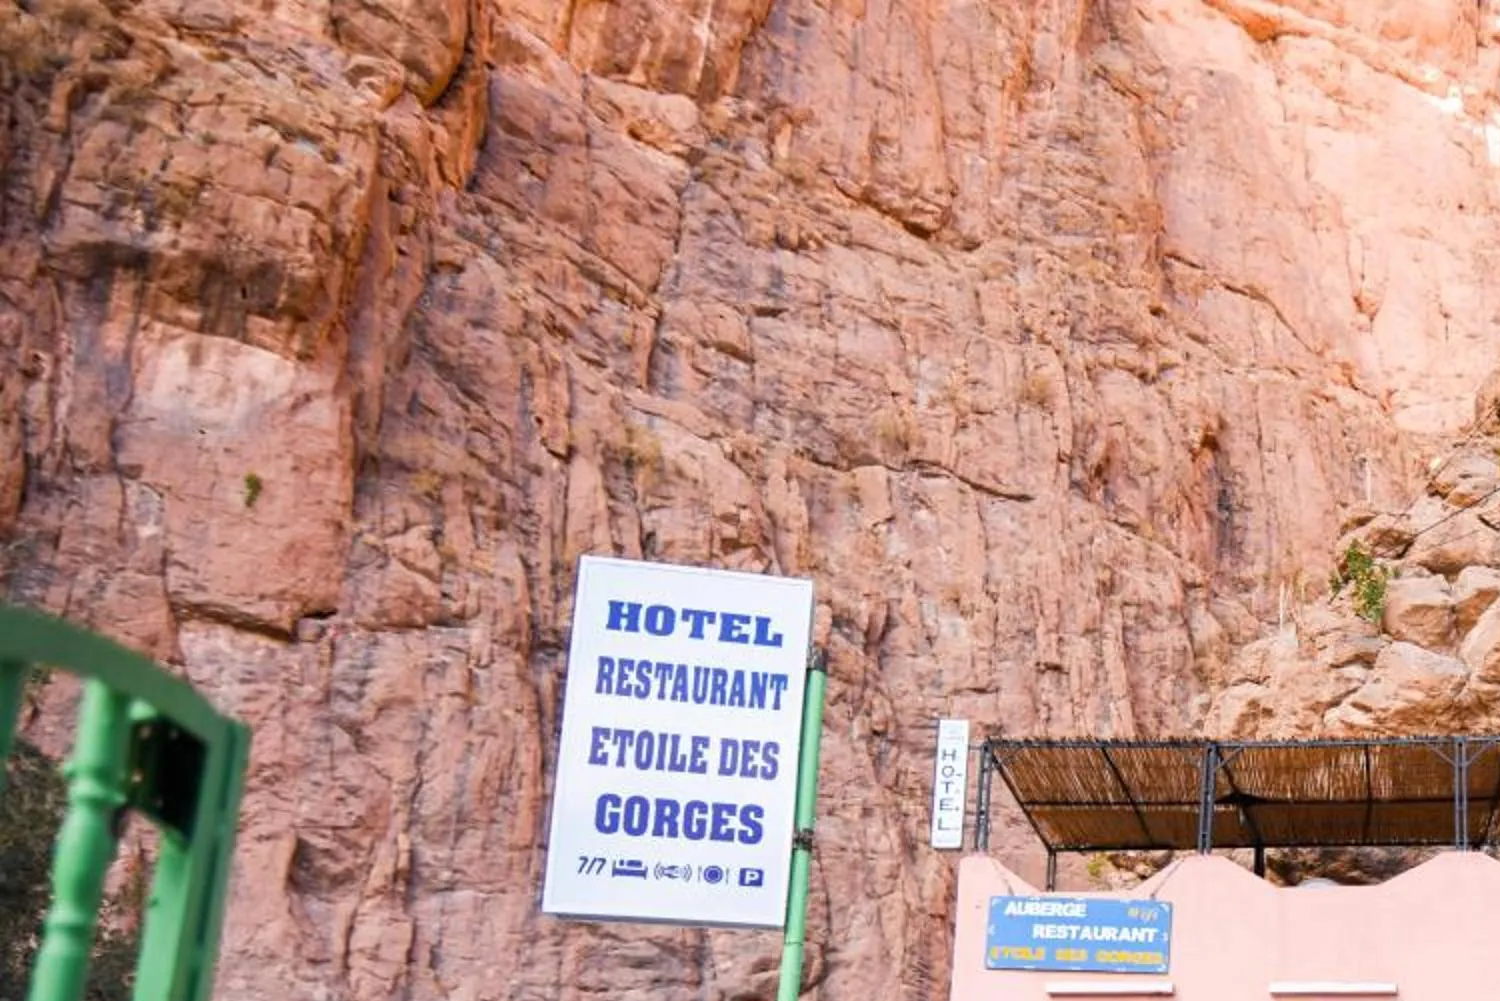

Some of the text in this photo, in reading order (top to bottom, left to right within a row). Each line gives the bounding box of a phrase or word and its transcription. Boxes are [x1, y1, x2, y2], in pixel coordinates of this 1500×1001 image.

[606, 600, 784, 648] HOTEL
[595, 655, 788, 711] RESTAURANT
[588, 726, 781, 781] ETOILE DES
[937, 748, 957, 831] HOTEL
[594, 793, 765, 845] GORGES
[577, 856, 607, 876] 7/7
[1004, 902, 1088, 917] AUBERGE
[1032, 924, 1159, 943] RESTAURANT
